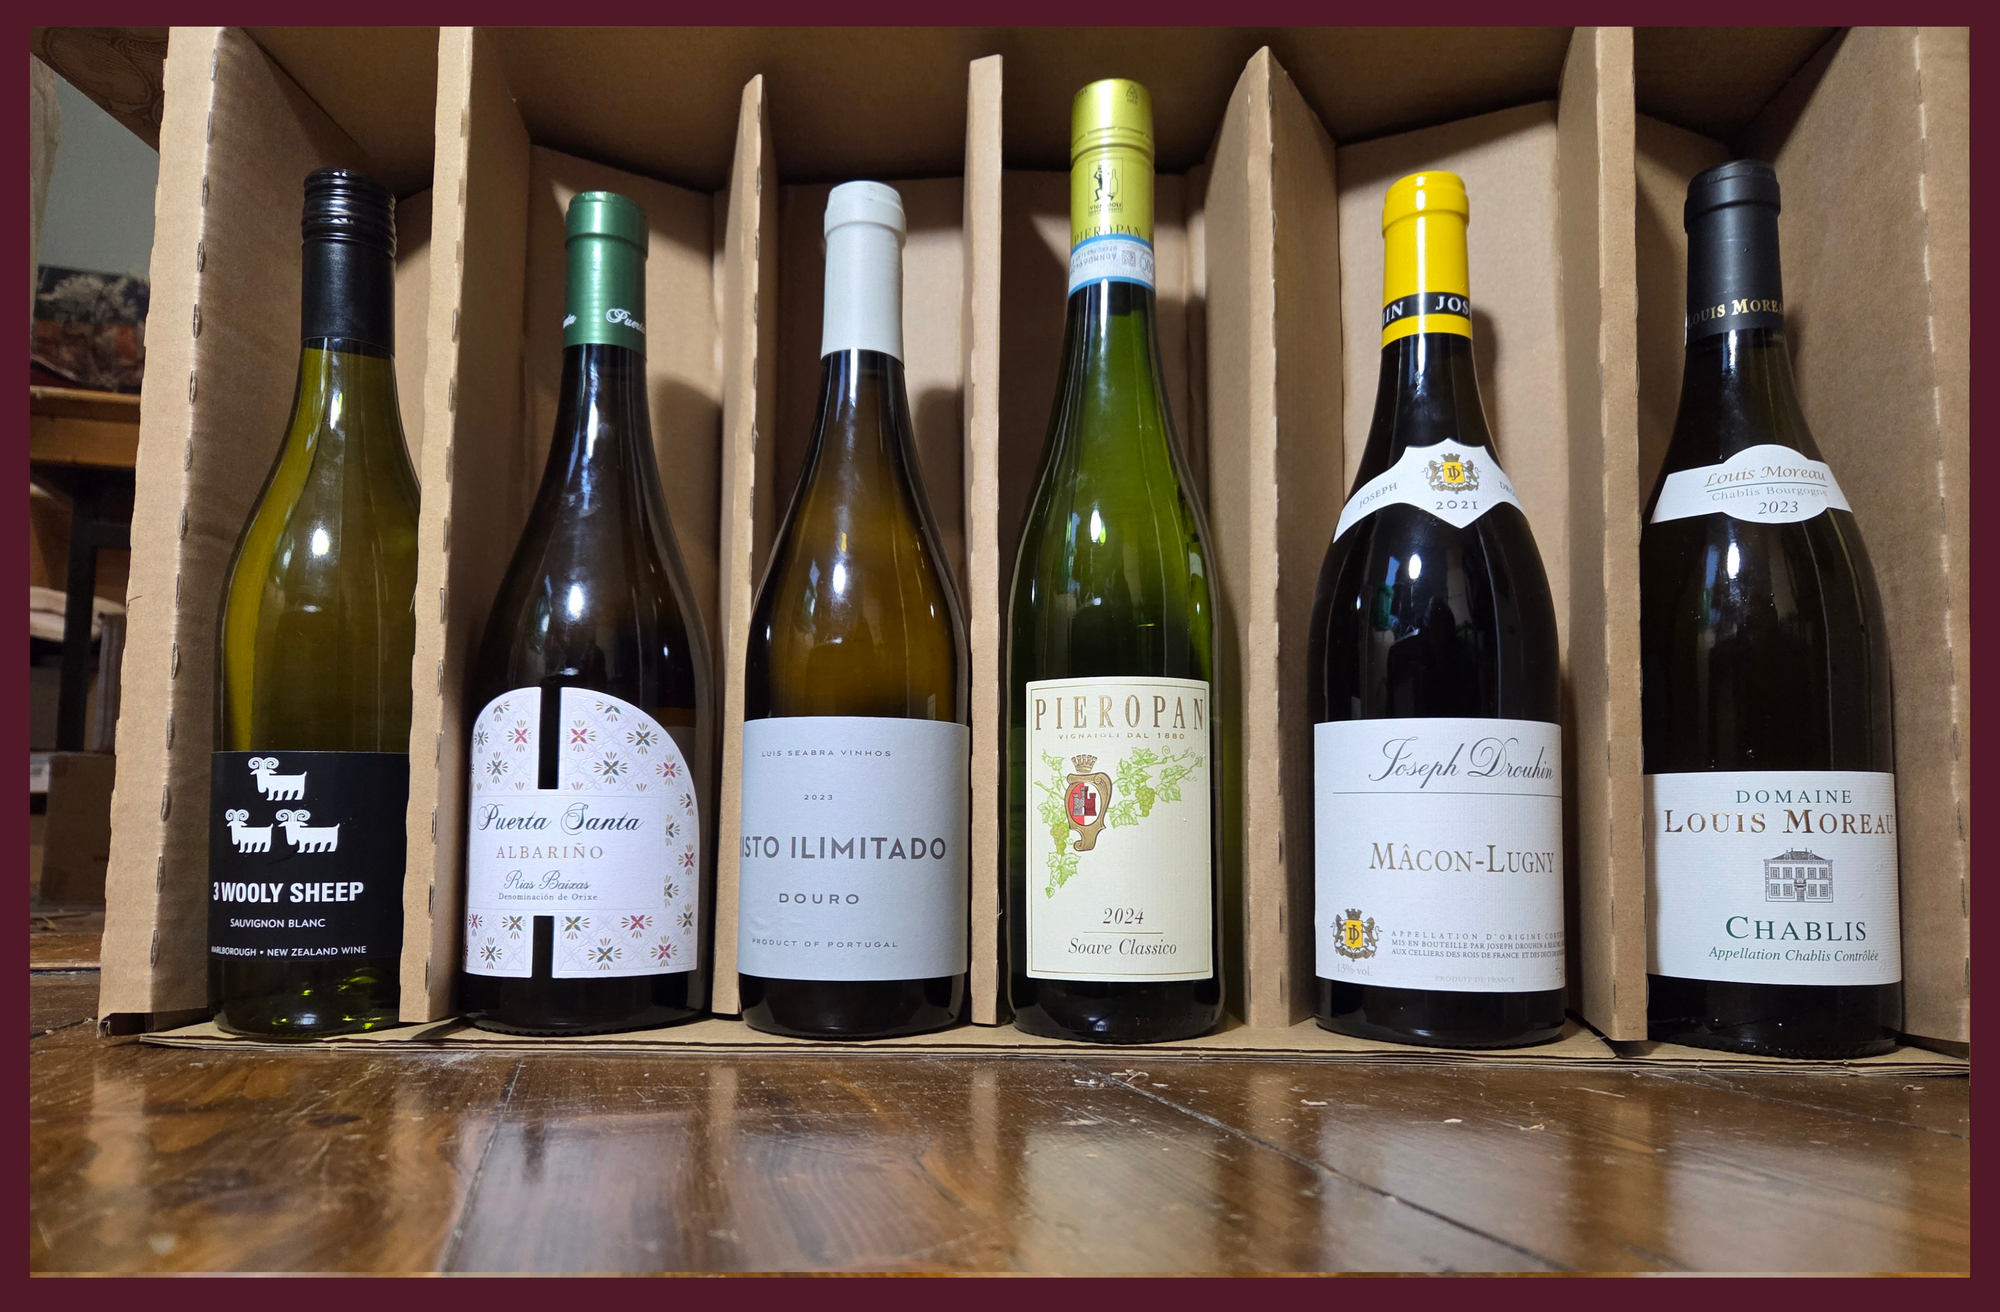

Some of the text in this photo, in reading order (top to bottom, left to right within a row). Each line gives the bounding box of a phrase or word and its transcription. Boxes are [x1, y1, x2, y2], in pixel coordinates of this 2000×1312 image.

[1704, 466, 1827, 488] Louis Moreau
[1358, 482, 1398, 510] JOSEPH
[1712, 486, 1828, 502] Chablis Bourgogne
[1436, 500, 1478, 510] 2021
[1758, 500, 1798, 515] 2023
[1035, 694, 1203, 731] PIEROPAN
[1058, 732, 1120, 740] VIGNAIOLI
[1157, 732, 1186, 740] 1880
[1368, 736, 1554, 790] Joseph Drouhin
[1736, 790, 1852, 804] DOMAINE
[476, 802, 645, 836] Puerta Santa
[1664, 809, 1894, 835] LOUIS MOREAU
[496, 842, 604, 860] ALBARIÑO
[739, 836, 947, 860] ISTO ILIMITADO
[1368, 842, 1554, 874] MÂCON-LUGNY
[538, 869, 592, 891] Baixas
[213, 881, 364, 904] 3 WOOLY SHEEP
[498, 892, 598, 902] Denominación de Orixe
[778, 893, 860, 905] DOURO
[230, 918, 326, 928] SAUVIGNON BLANC
[1102, 907, 1145, 926] 2024
[1391, 931, 1478, 940] APPELLATION
[1486, 932, 1542, 941] D'ORIGINE
[1725, 916, 1867, 942] CHABLIS
[752, 938, 798, 947] PRODUCT
[827, 940, 899, 948] PORTUGAL
[1068, 937, 1178, 956] Soave Classico
[1422, 940, 1468, 949] BOUTEILLE
[1470, 942, 1485, 950] PAR
[1486, 942, 1513, 950] JOSEPH
[266, 948, 288, 957] NEW
[291, 947, 338, 957] ZEALAND
[341, 946, 367, 955] WINE
[1408, 949, 1444, 958] CELLIERS
[1708, 946, 1879, 962] Appellation Chablis Contrôlée
[1356, 965, 1373, 977] vol.
[1435, 976, 1472, 984] PRODUIT
[1488, 976, 1516, 984] FRANCE
